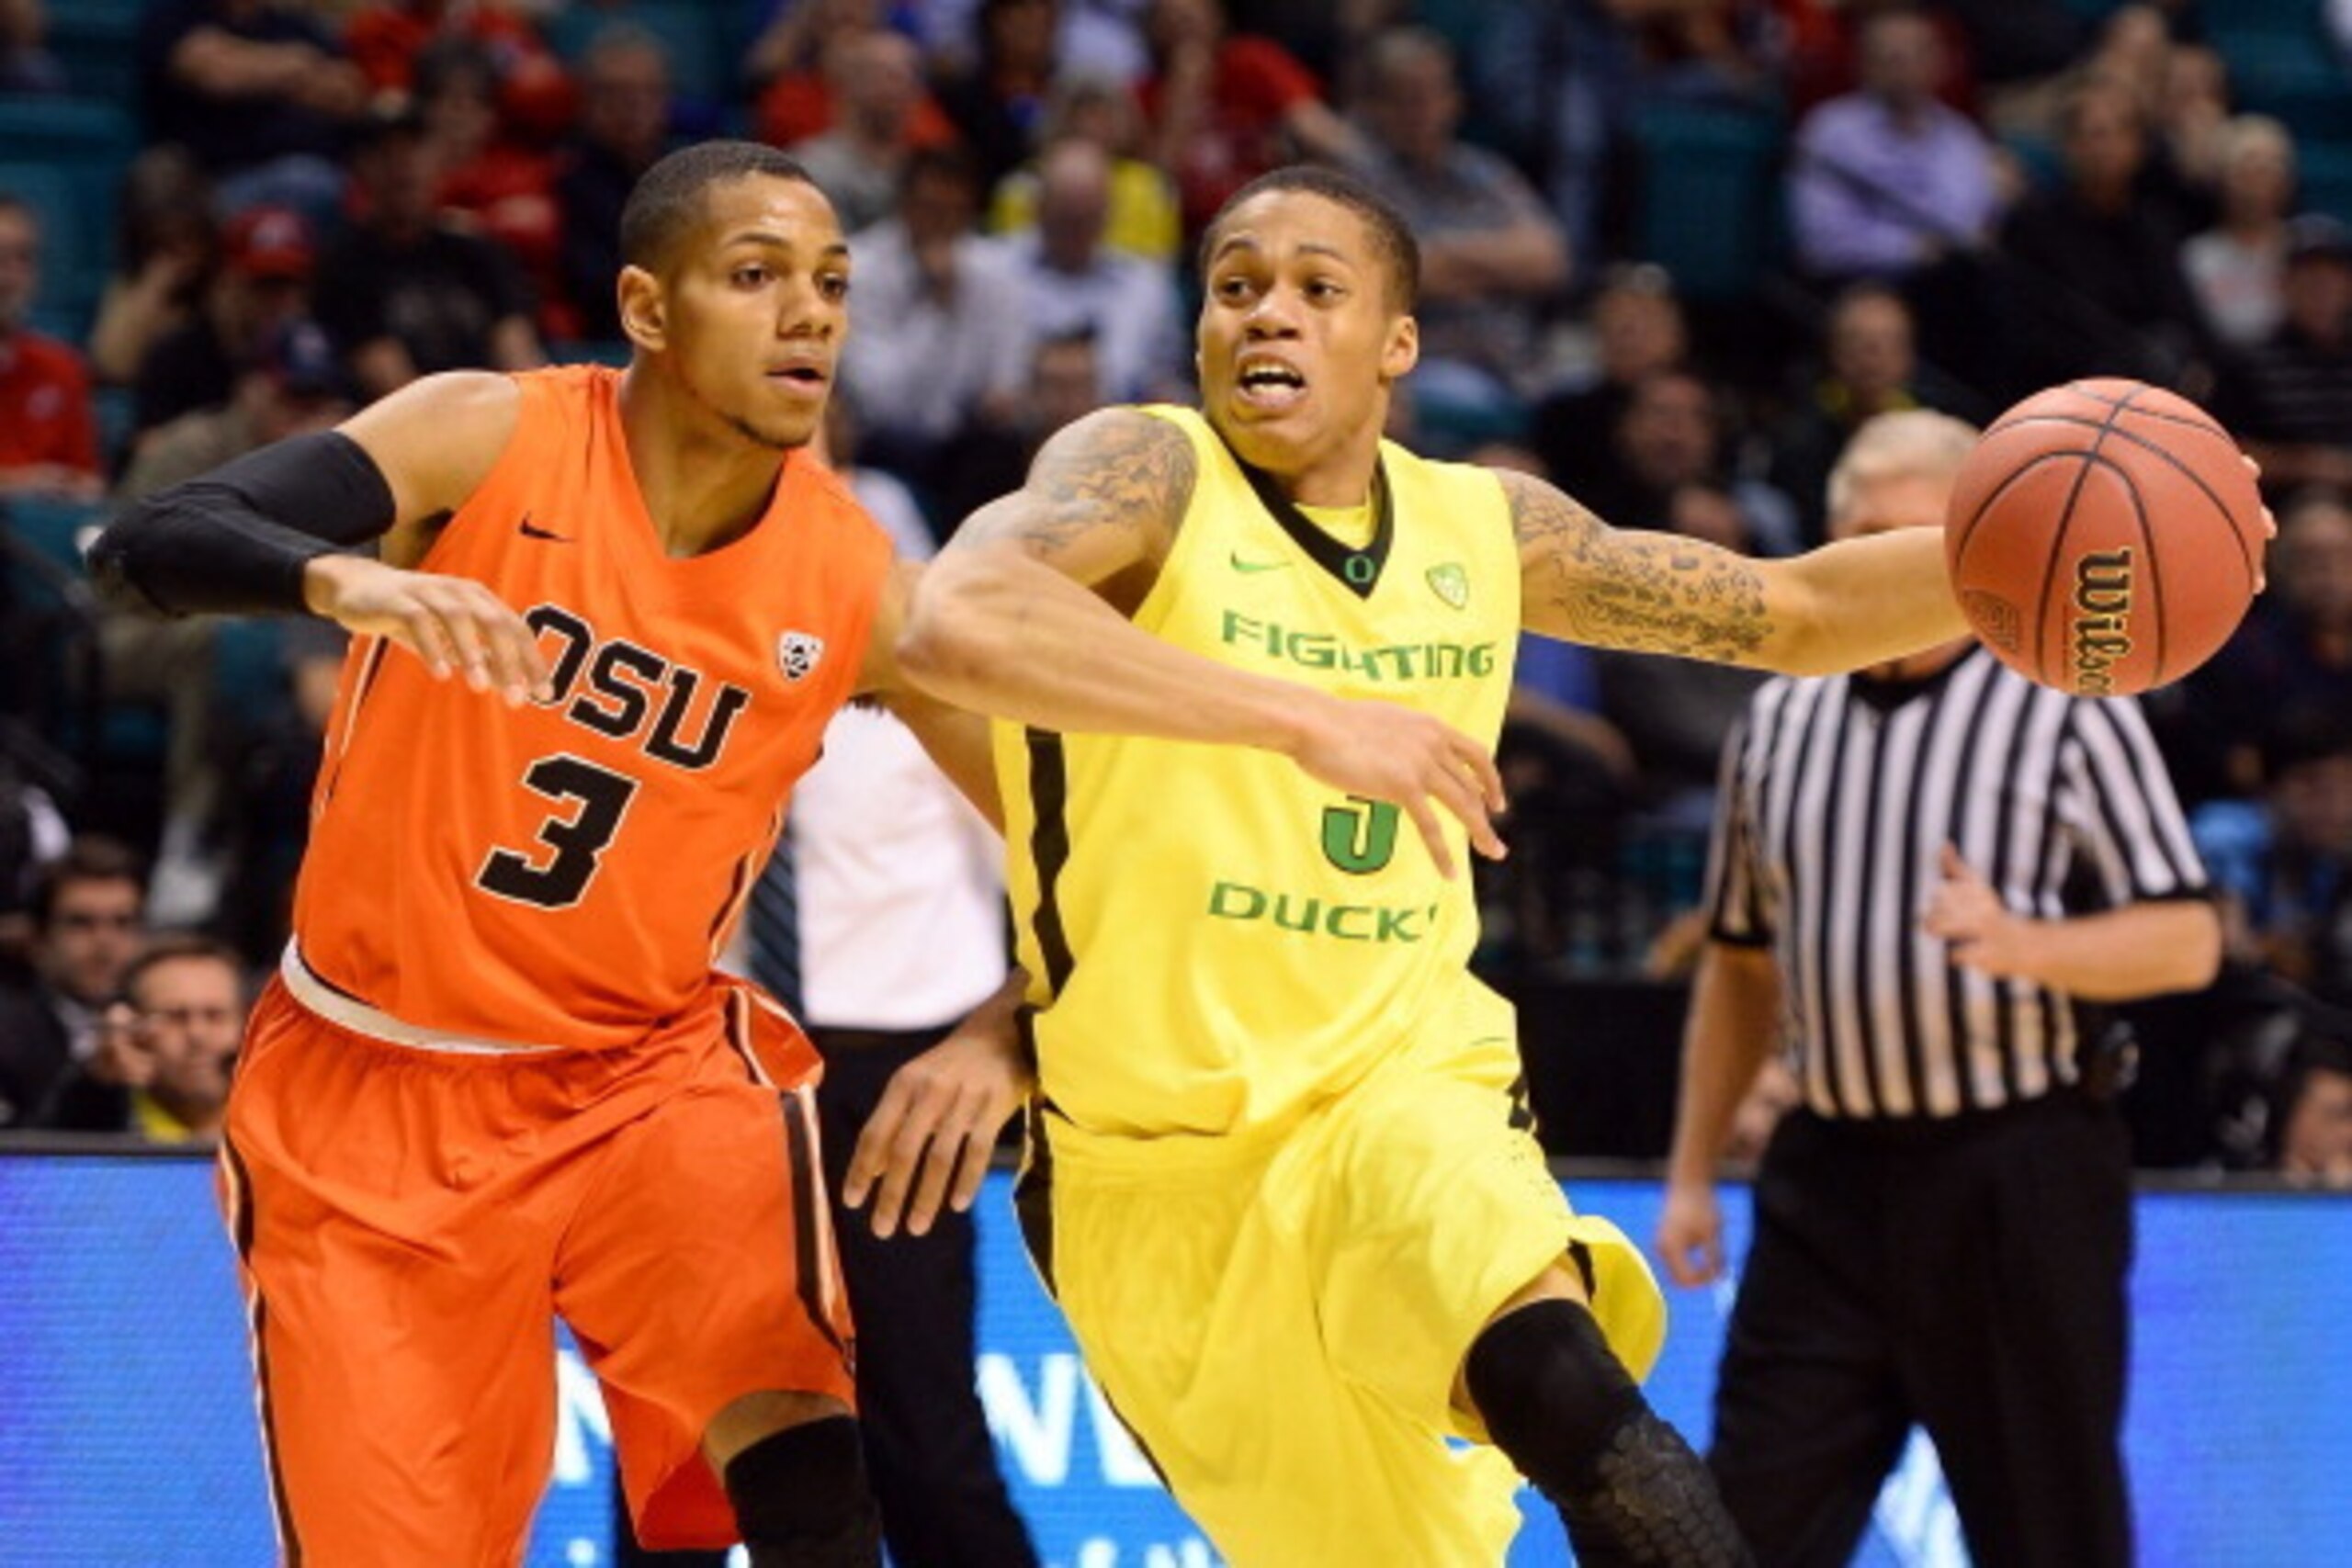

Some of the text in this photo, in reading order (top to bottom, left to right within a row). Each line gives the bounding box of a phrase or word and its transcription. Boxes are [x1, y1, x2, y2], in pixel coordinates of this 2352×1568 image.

[1345, 554, 1375, 583] O
[1222, 609, 1497, 681] FIGHTING
[526, 604, 752, 770] OSU
[473, 752, 641, 911] 3
[1208, 881, 1439, 943] DUCK
